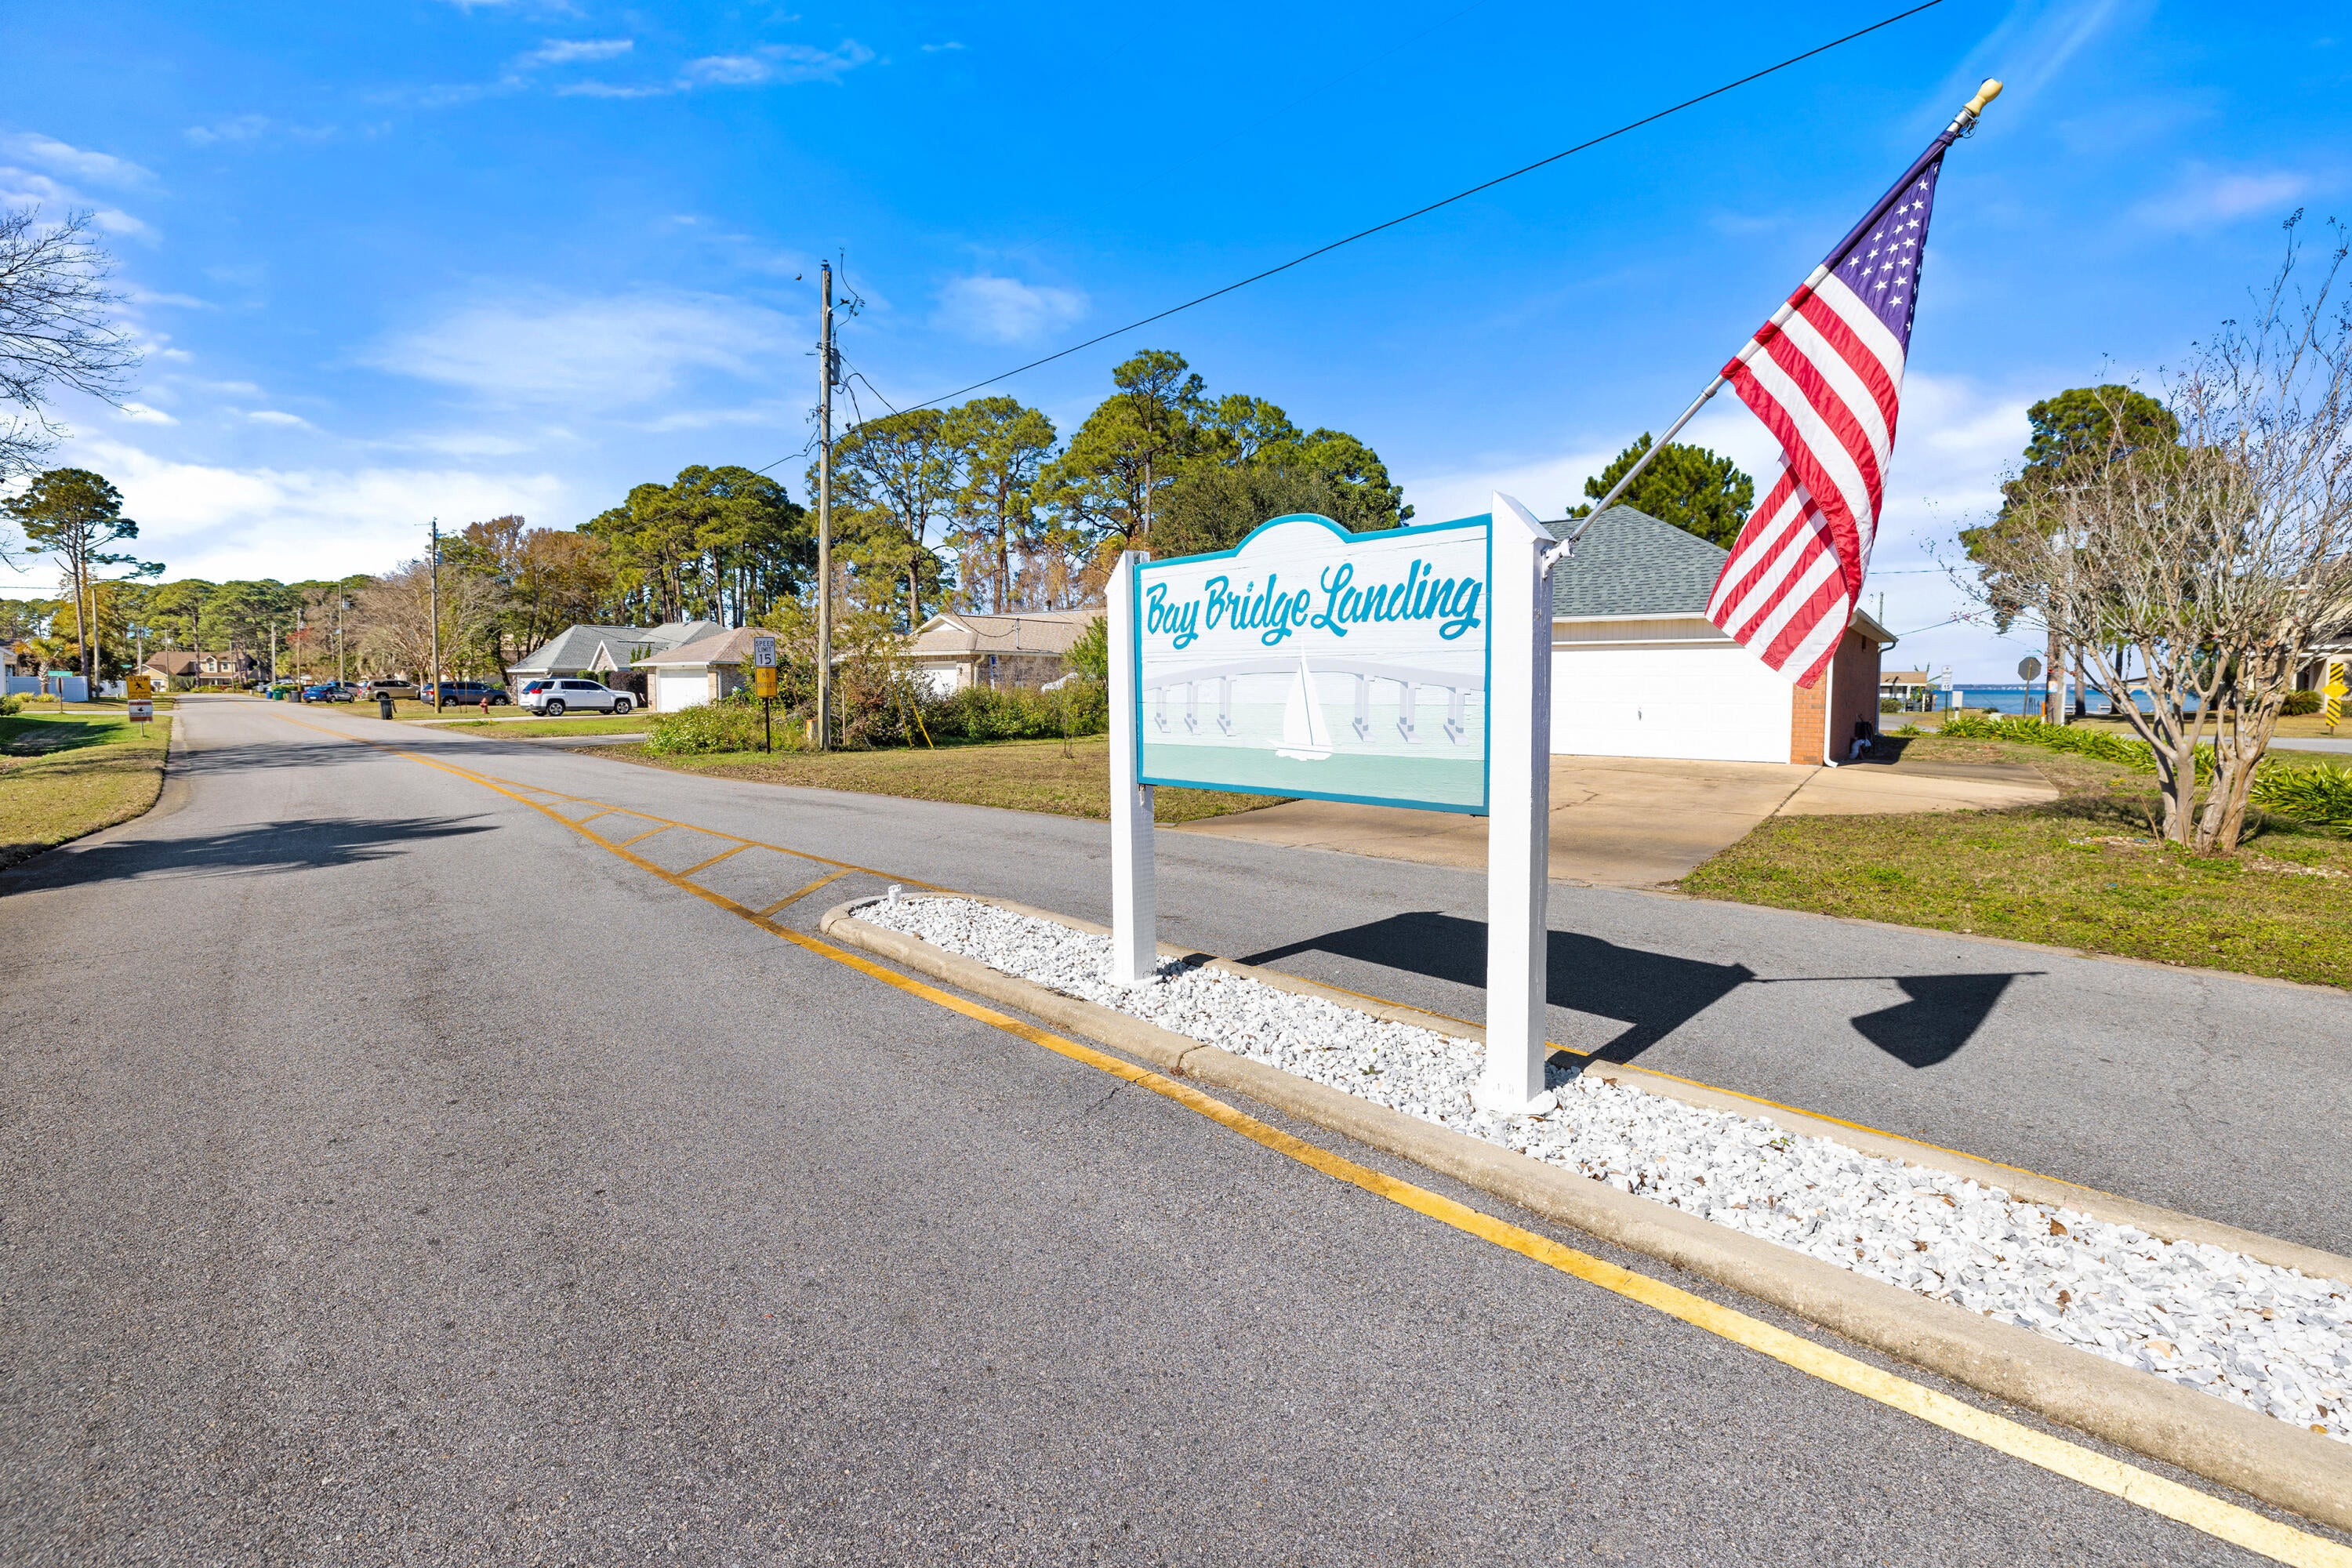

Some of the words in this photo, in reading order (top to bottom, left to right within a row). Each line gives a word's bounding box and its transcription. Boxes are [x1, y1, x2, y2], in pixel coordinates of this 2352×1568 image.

[1146, 582, 1200, 650] Bay
[1204, 573, 1310, 647] Bridge
[1311, 558, 1483, 641] Landing
[760, 654, 771, 665] 15
